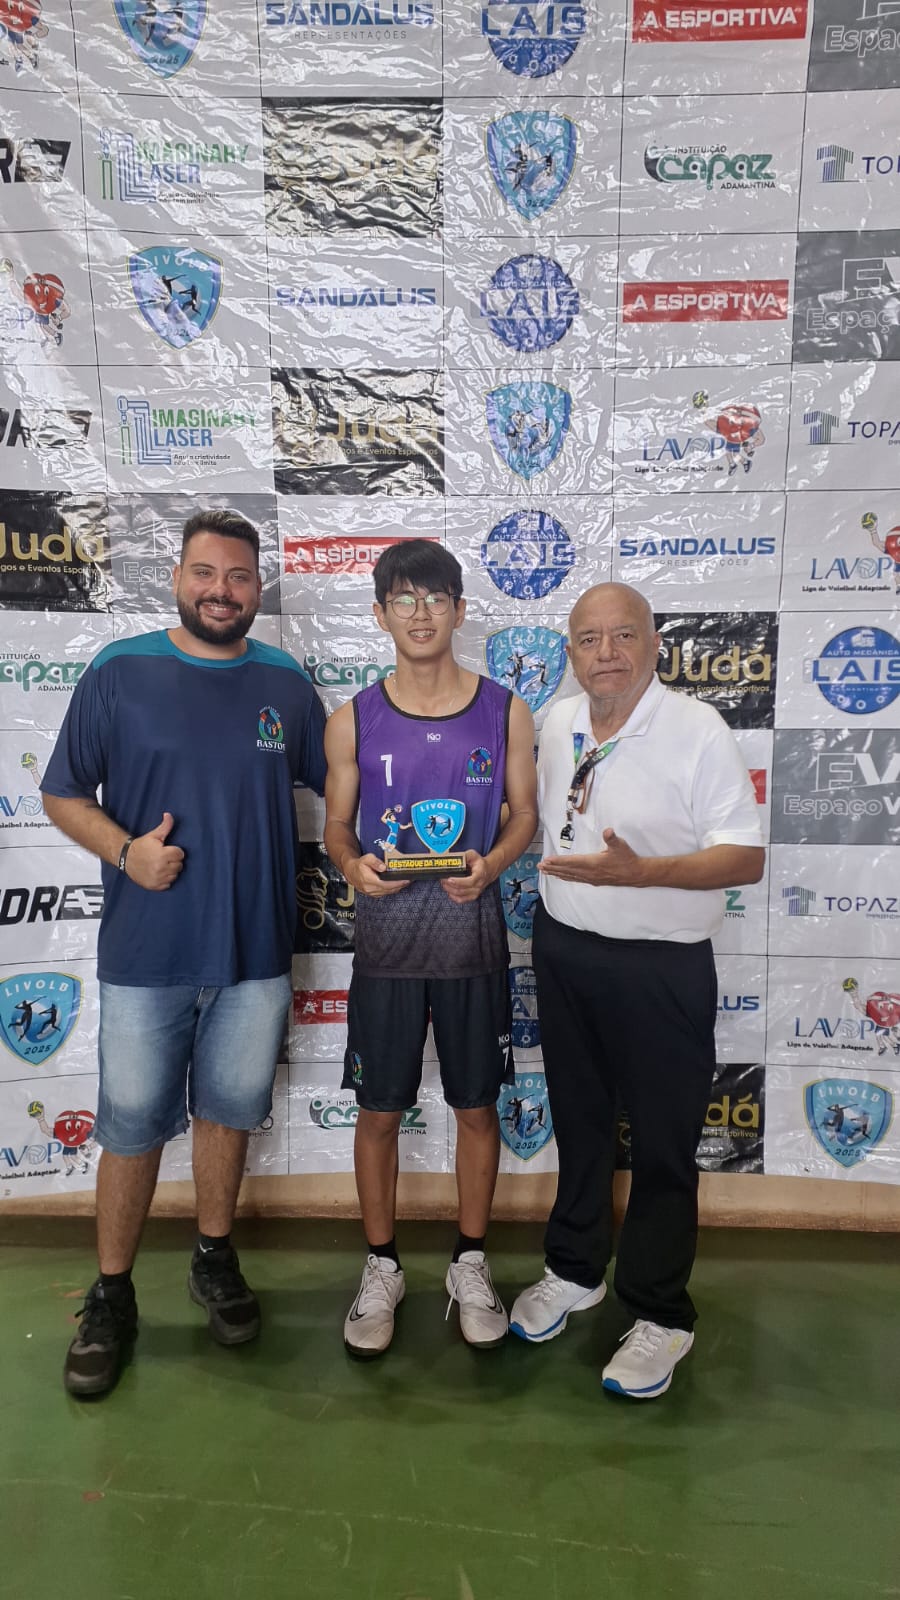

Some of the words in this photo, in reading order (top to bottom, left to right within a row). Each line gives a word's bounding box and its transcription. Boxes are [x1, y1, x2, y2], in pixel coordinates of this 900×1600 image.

[266, 3, 434, 26] SANDALUS
[481, 6, 586, 36] LAIS
[640, 12, 659, 28] A
[665, 7, 797, 28] ESPORTIVA
[276, 287, 437, 307] SANDALUS
[632, 293, 649, 310] A
[654, 291, 779, 311] ESPORTIVA
[154, 428, 213, 447] LASER
[620, 537, 776, 556] SANDALUS
[28, 564, 61, 573] Eventos
[659, 642, 772, 682] Judá
[812, 659, 900, 682] LAIS
[420, 802, 457, 813] LIVOLB
[388, 859, 423, 868] DESTAQUE
[434, 858, 462, 866] PARTIDA
[4, 979, 70, 998] LIVOLB
[24, 1044, 52, 1055] 2025
[818, 1086, 881, 1102] LIVOLB
[515, 1141, 537, 1149] 2025
